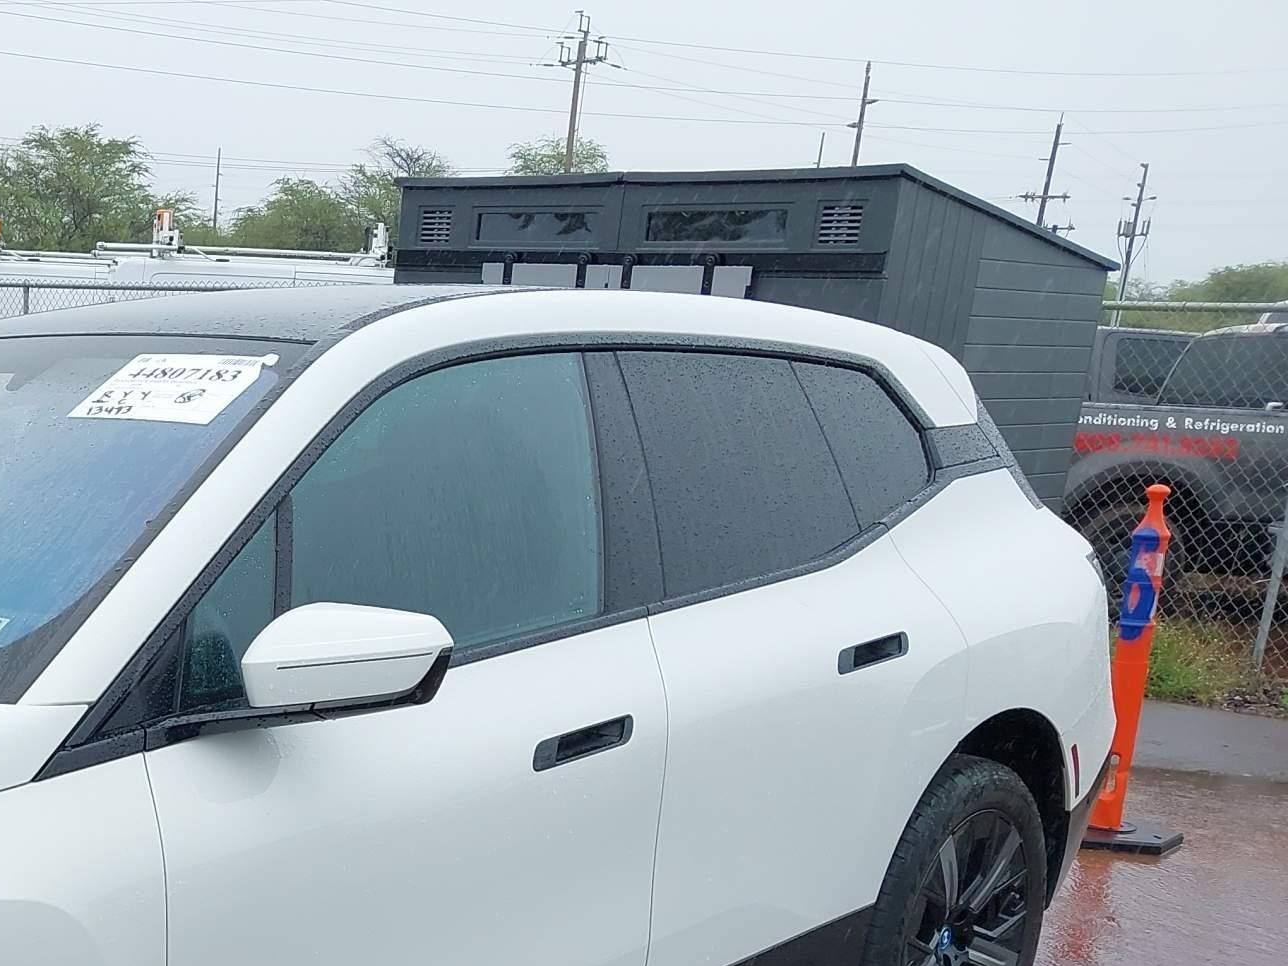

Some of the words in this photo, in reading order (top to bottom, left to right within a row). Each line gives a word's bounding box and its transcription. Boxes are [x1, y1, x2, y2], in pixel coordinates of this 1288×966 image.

[128, 366, 242, 382] 44807183
[1166, 416, 1177, 429] &
[1184, 417, 1285, 434] Refrigeration
